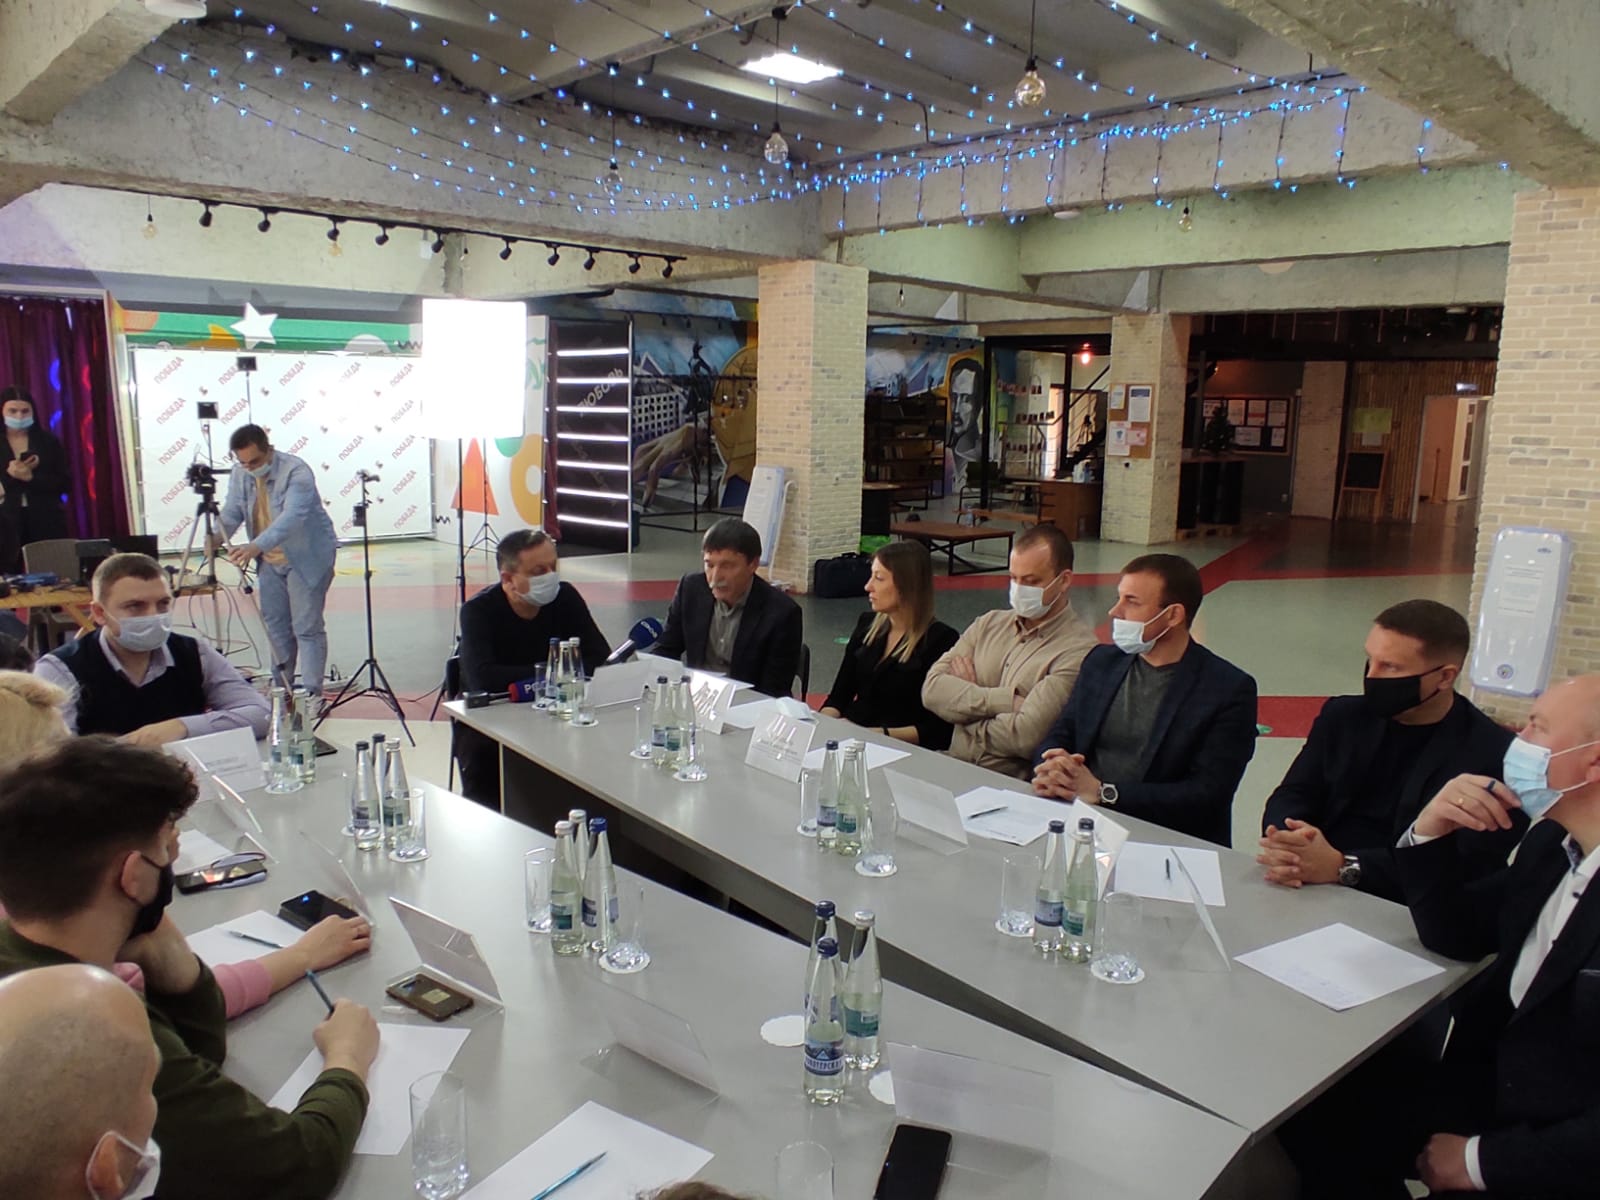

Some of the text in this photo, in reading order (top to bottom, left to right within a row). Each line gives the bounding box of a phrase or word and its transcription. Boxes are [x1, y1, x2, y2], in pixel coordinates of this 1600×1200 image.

[153, 356, 184, 384] ПОБЕДА
[218, 363, 239, 385] ПОБЕ
[280, 360, 306, 387] ПОБЕДА
[156, 397, 186, 424] ПОБЕДА
[220, 398, 250, 424] ПОБЕДА
[281, 399, 307, 424] ПОБЕДА
[158, 437, 188, 465] ПОБЕДА
[287, 436, 309, 454] ОБЕДА
[338, 435, 364, 461] ПОБЕДА
[392, 434, 415, 459] ПОБЕДА
[161, 477, 189, 505] ПОБЕД
[340, 472, 361, 497] ПОБЕД
[392, 470, 416, 495] ПОБЕДА
[164, 515, 193, 543] ПОБЕДА
[394, 504, 418, 529] ПОБЕДА
